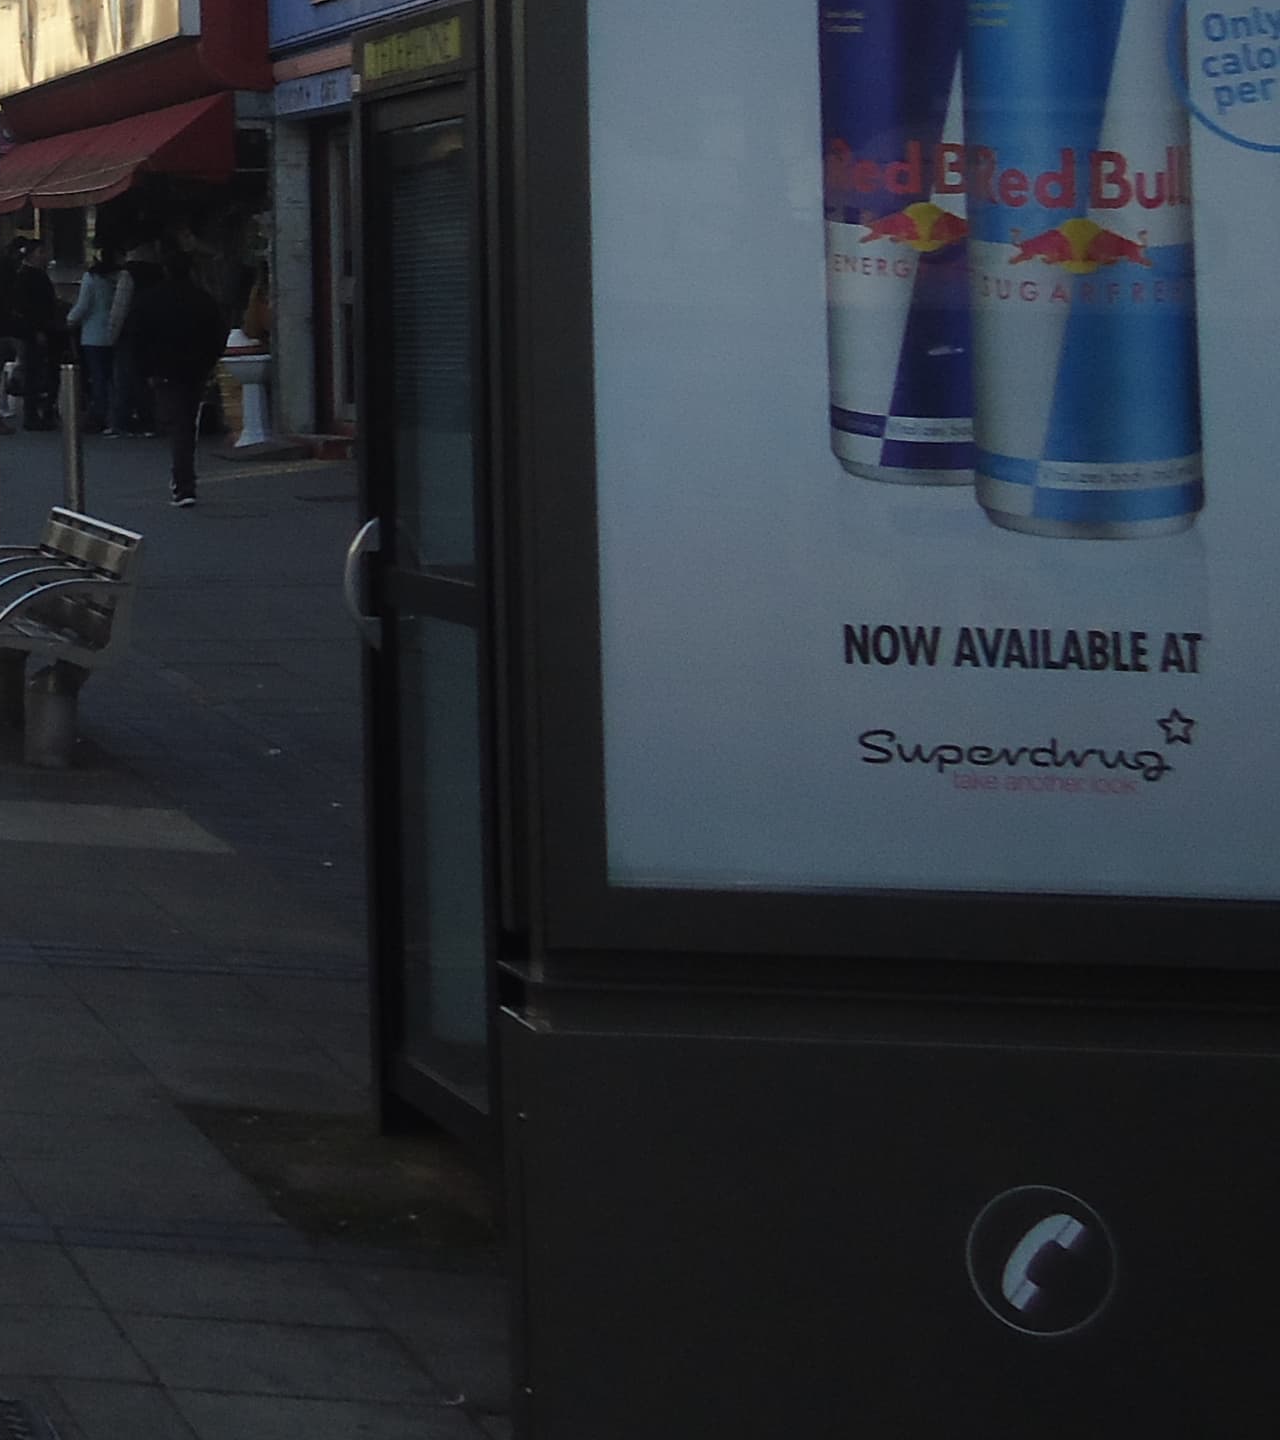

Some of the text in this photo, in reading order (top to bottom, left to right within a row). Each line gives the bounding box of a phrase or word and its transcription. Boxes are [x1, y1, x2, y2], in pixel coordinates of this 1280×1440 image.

[1213, 77, 1275, 116] per
[975, 144, 1190, 210] Red Bull
[832, 252, 930, 278] ENERG
[843, 623, 1203, 673] NOW AVAILABLE AT
[858, 728, 1173, 782] Superdrug
